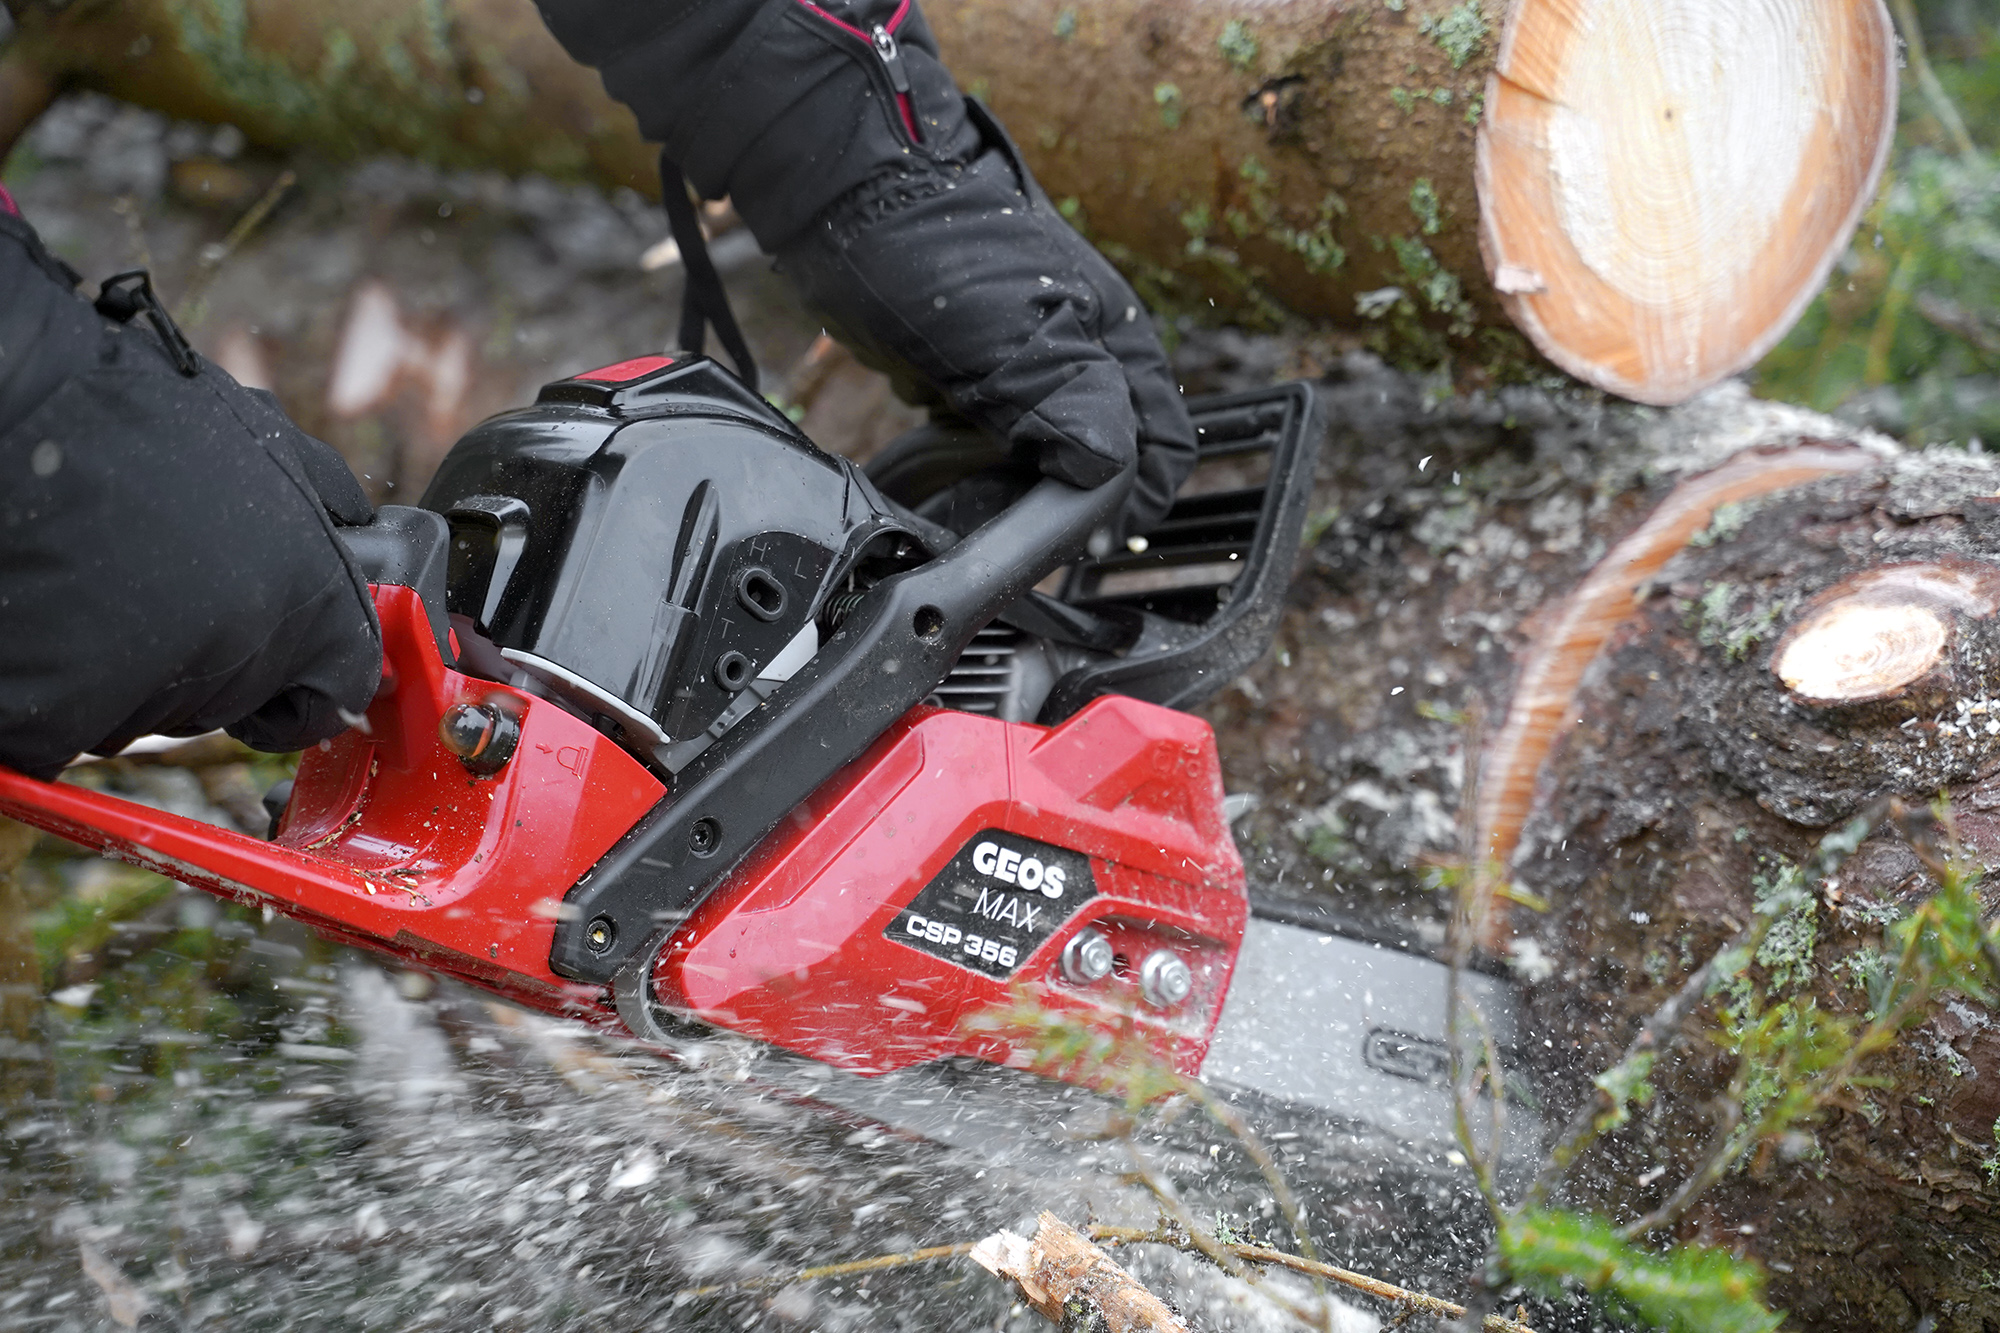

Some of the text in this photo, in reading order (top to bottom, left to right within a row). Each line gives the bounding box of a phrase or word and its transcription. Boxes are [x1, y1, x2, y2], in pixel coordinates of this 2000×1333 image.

[749, 537, 767, 562] H
[794, 556, 807, 580] L
[721, 617, 735, 639] T
[972, 841, 1067, 899] GEOS
[972, 887, 1042, 933] MAX
[906, 915, 1018, 968] CSP 356
